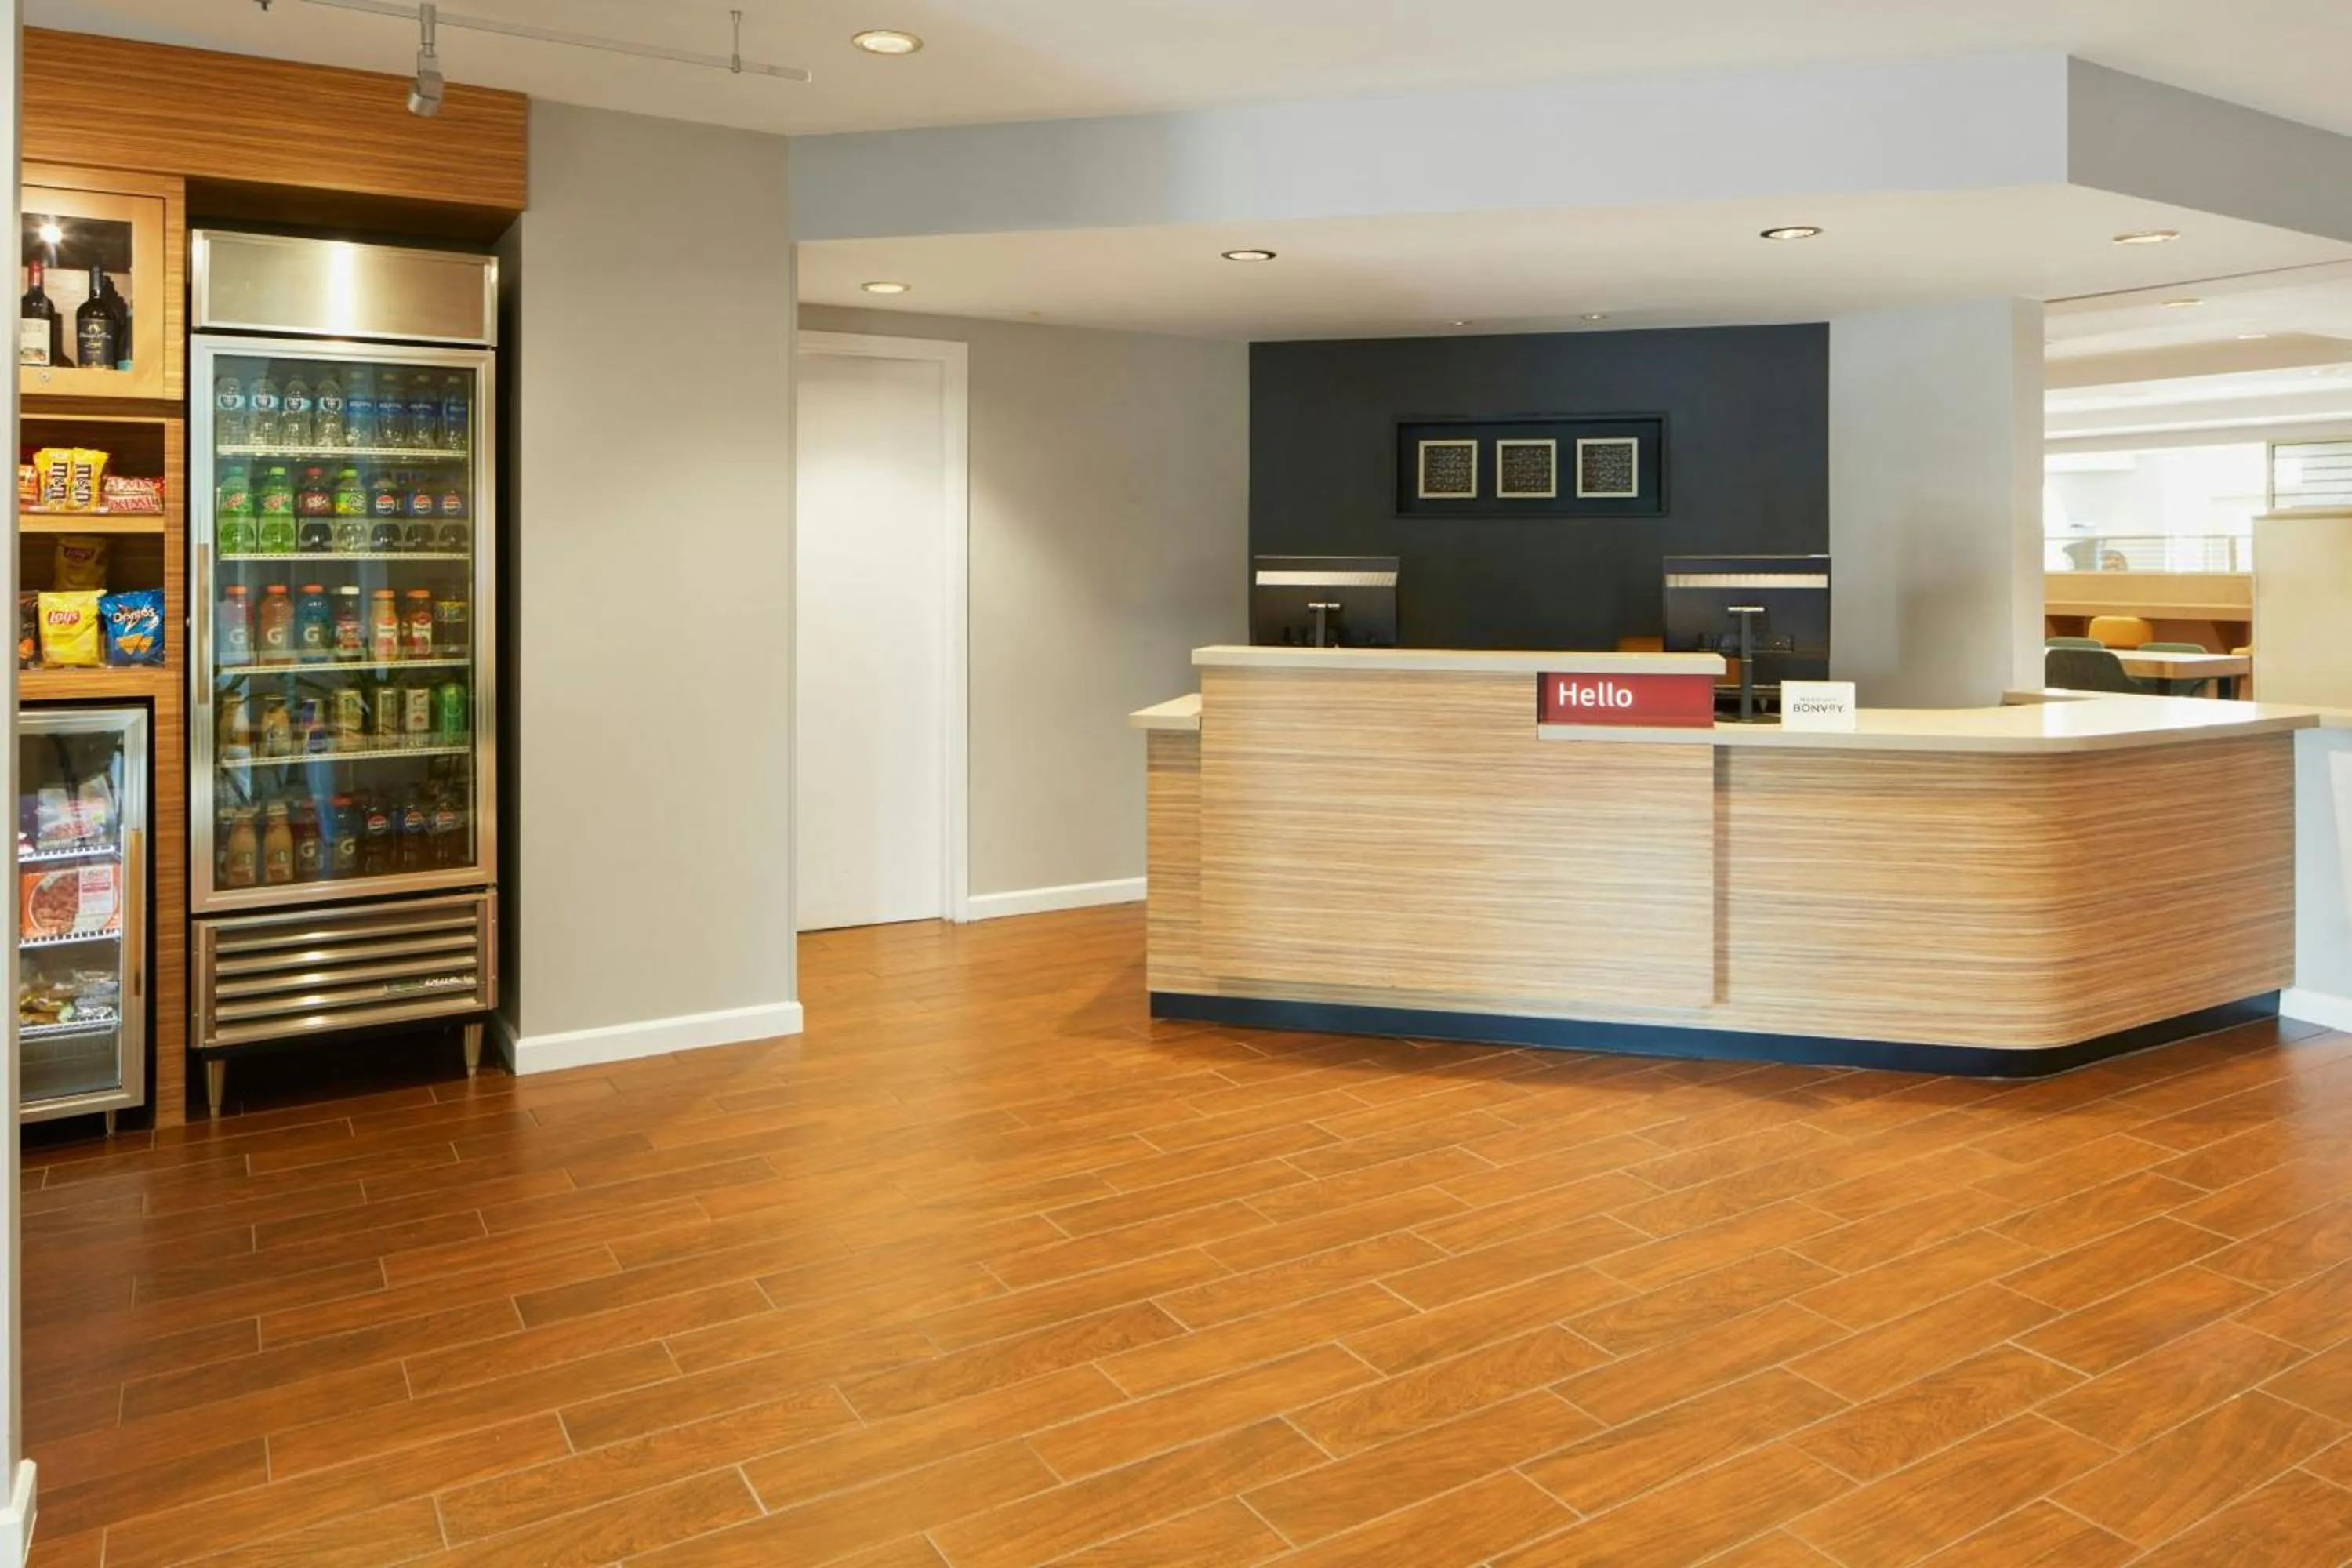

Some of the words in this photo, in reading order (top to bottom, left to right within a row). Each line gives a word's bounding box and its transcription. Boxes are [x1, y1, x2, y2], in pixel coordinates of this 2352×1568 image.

[230, 627, 246, 644] G
[267, 627, 283, 645] G
[304, 626, 320, 642] G
[1559, 681, 1633, 707] Hello
